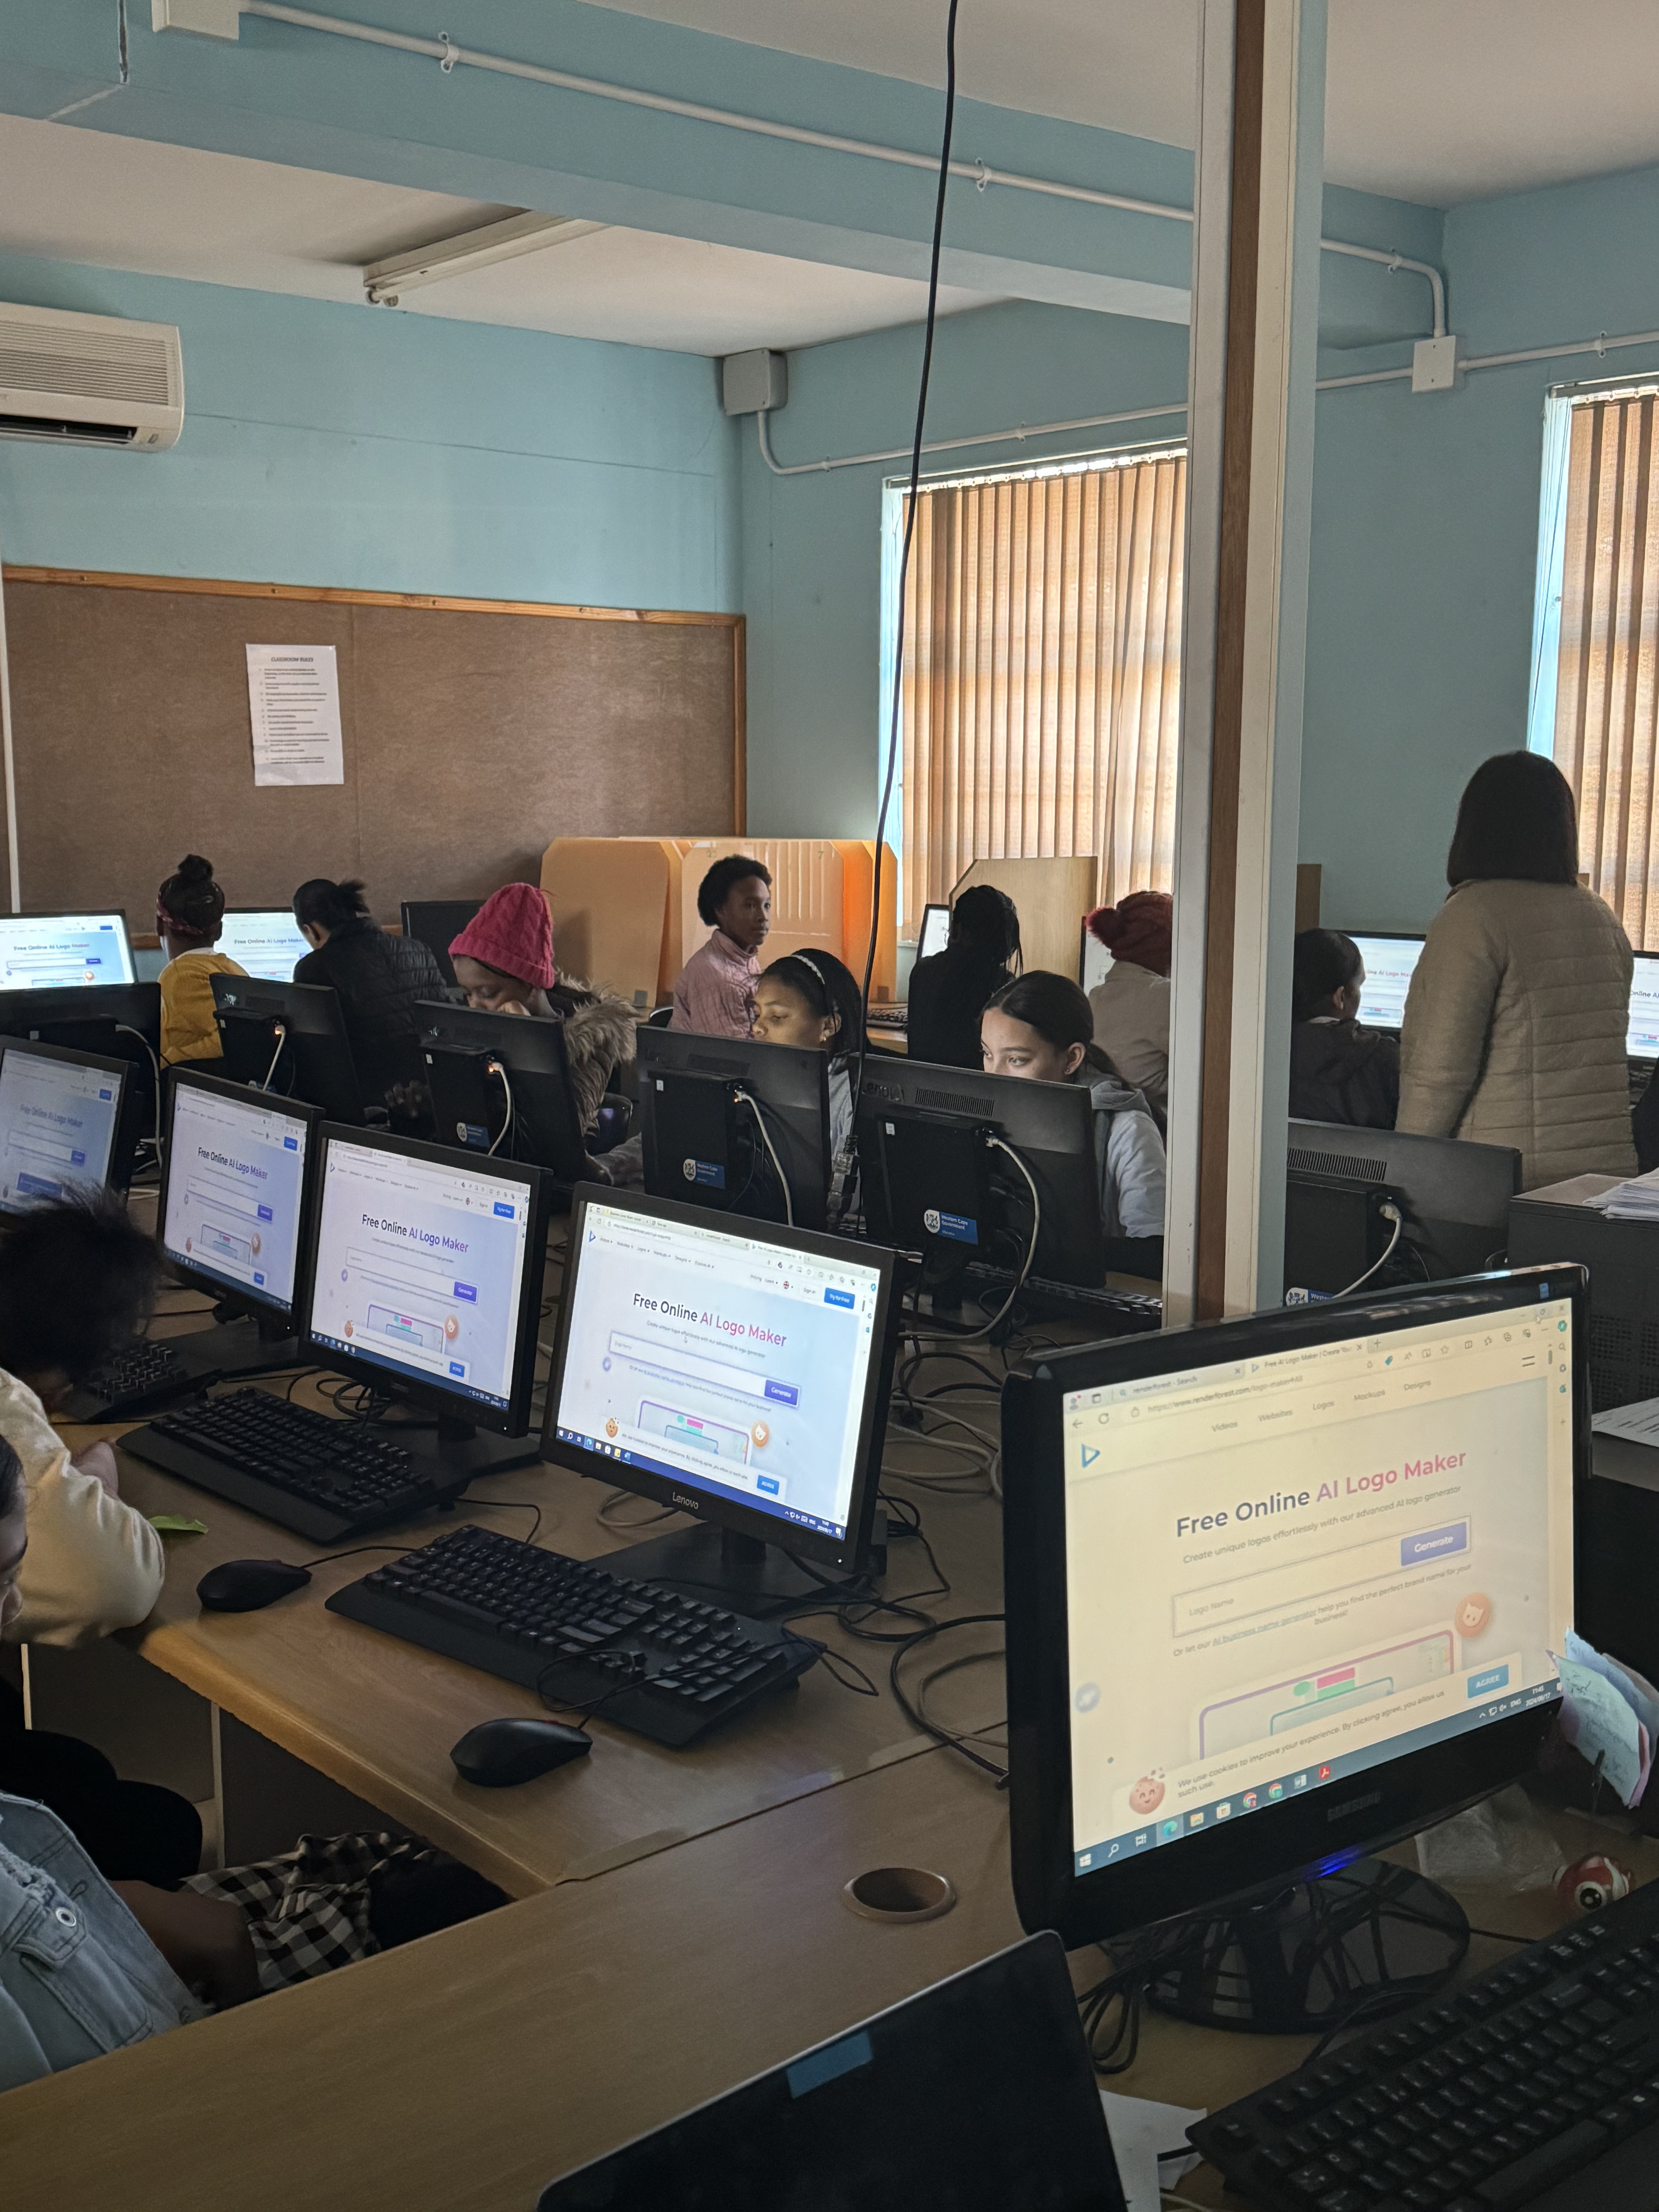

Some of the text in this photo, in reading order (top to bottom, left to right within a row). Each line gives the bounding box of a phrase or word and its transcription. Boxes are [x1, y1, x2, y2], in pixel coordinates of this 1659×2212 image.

[198, 1147, 210, 1159] Free
[211, 1152, 228, 1165] Online
[236, 1161, 249, 1174] Logo
[362, 1214, 379, 1228] Free
[381, 1219, 407, 1236] Online
[409, 1228, 417, 1239] AI
[420, 1230, 440, 1246] Logo
[442, 1236, 468, 1253] Maker
[941, 1220, 965, 1230] Government
[633, 1293, 787, 1347] Free Online AI Logo Maker
[771, 1387, 792, 1398] Generate
[1212, 1380, 1431, 1432] Videos Websites Logos Mockups Designs
[672, 1492, 699, 1510] Lenovo
[1177, 1453, 1466, 1537] Free Online AI Logo Maker
[1183, 1486, 1461, 1564] Create unique logos effortlessly with our advanced AI logo generator
[1414, 1536, 1454, 1553] Generate
[1173, 1648, 1183, 1657] Or
[1185, 1645, 1195, 1654] let
[1197, 1641, 1210, 1650] our
[1318, 1604, 1334, 1616] help
[1335, 1600, 1349, 1609] you
[1350, 1594, 1364, 1605] find
[1366, 1590, 1377, 1600] the
[1379, 1583, 1403, 1597] perfect
[1405, 1577, 1425, 1588] brand
[1426, 1572, 1446, 1582] name
[1456, 1564, 1472, 1575] your
[1189, 1598, 1234, 1616] Logo Name
[1476, 1675, 1500, 1688] AGREE
[1511, 1698, 1522, 1707] ENG
[1178, 1779, 1192, 1788] We
[1193, 1773, 1207, 1783] use
[1209, 1762, 1238, 1777] cookies
[1249, 1748, 1280, 1764] improve
[1281, 1741, 1298, 1753] your
[1300, 1727, 1340, 1745] experience.
[1342, 1722, 1352, 1731] By
[1353, 1713, 1380, 1727] clicking
[1381, 1705, 1402, 1717] agree,
[1403, 1701, 1416, 1711] you
[1417, 1694, 1435, 1704] allow
[1178, 1780, 1214, 1798] such use.
